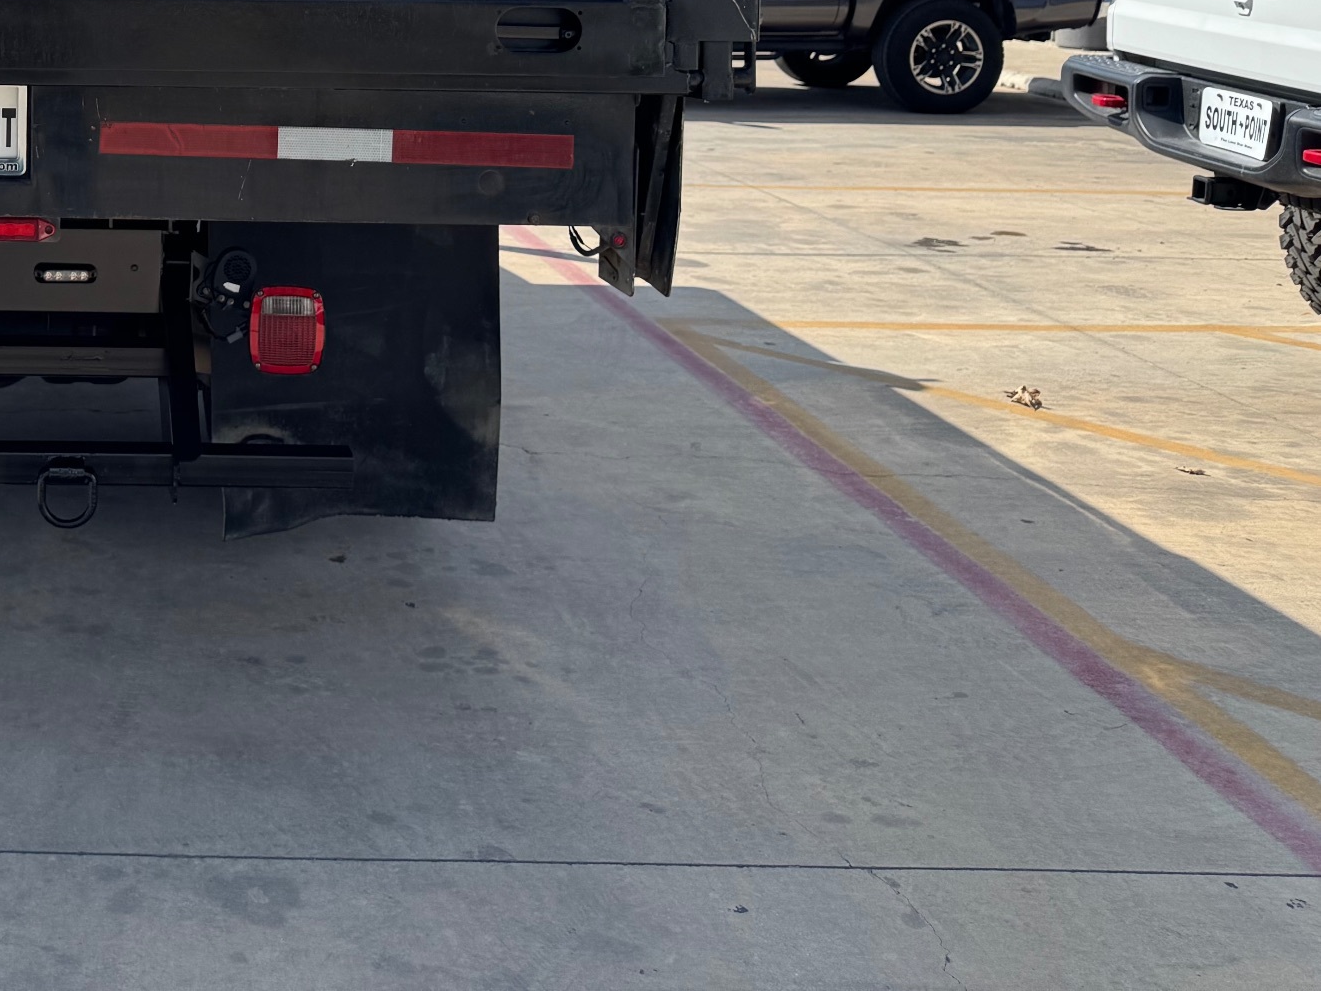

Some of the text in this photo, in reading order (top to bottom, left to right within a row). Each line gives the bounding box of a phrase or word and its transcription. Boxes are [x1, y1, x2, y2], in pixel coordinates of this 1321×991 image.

[1229, 95, 1254, 110] TEXAS
[1204, 105, 1268, 144] SOUTH POINT
